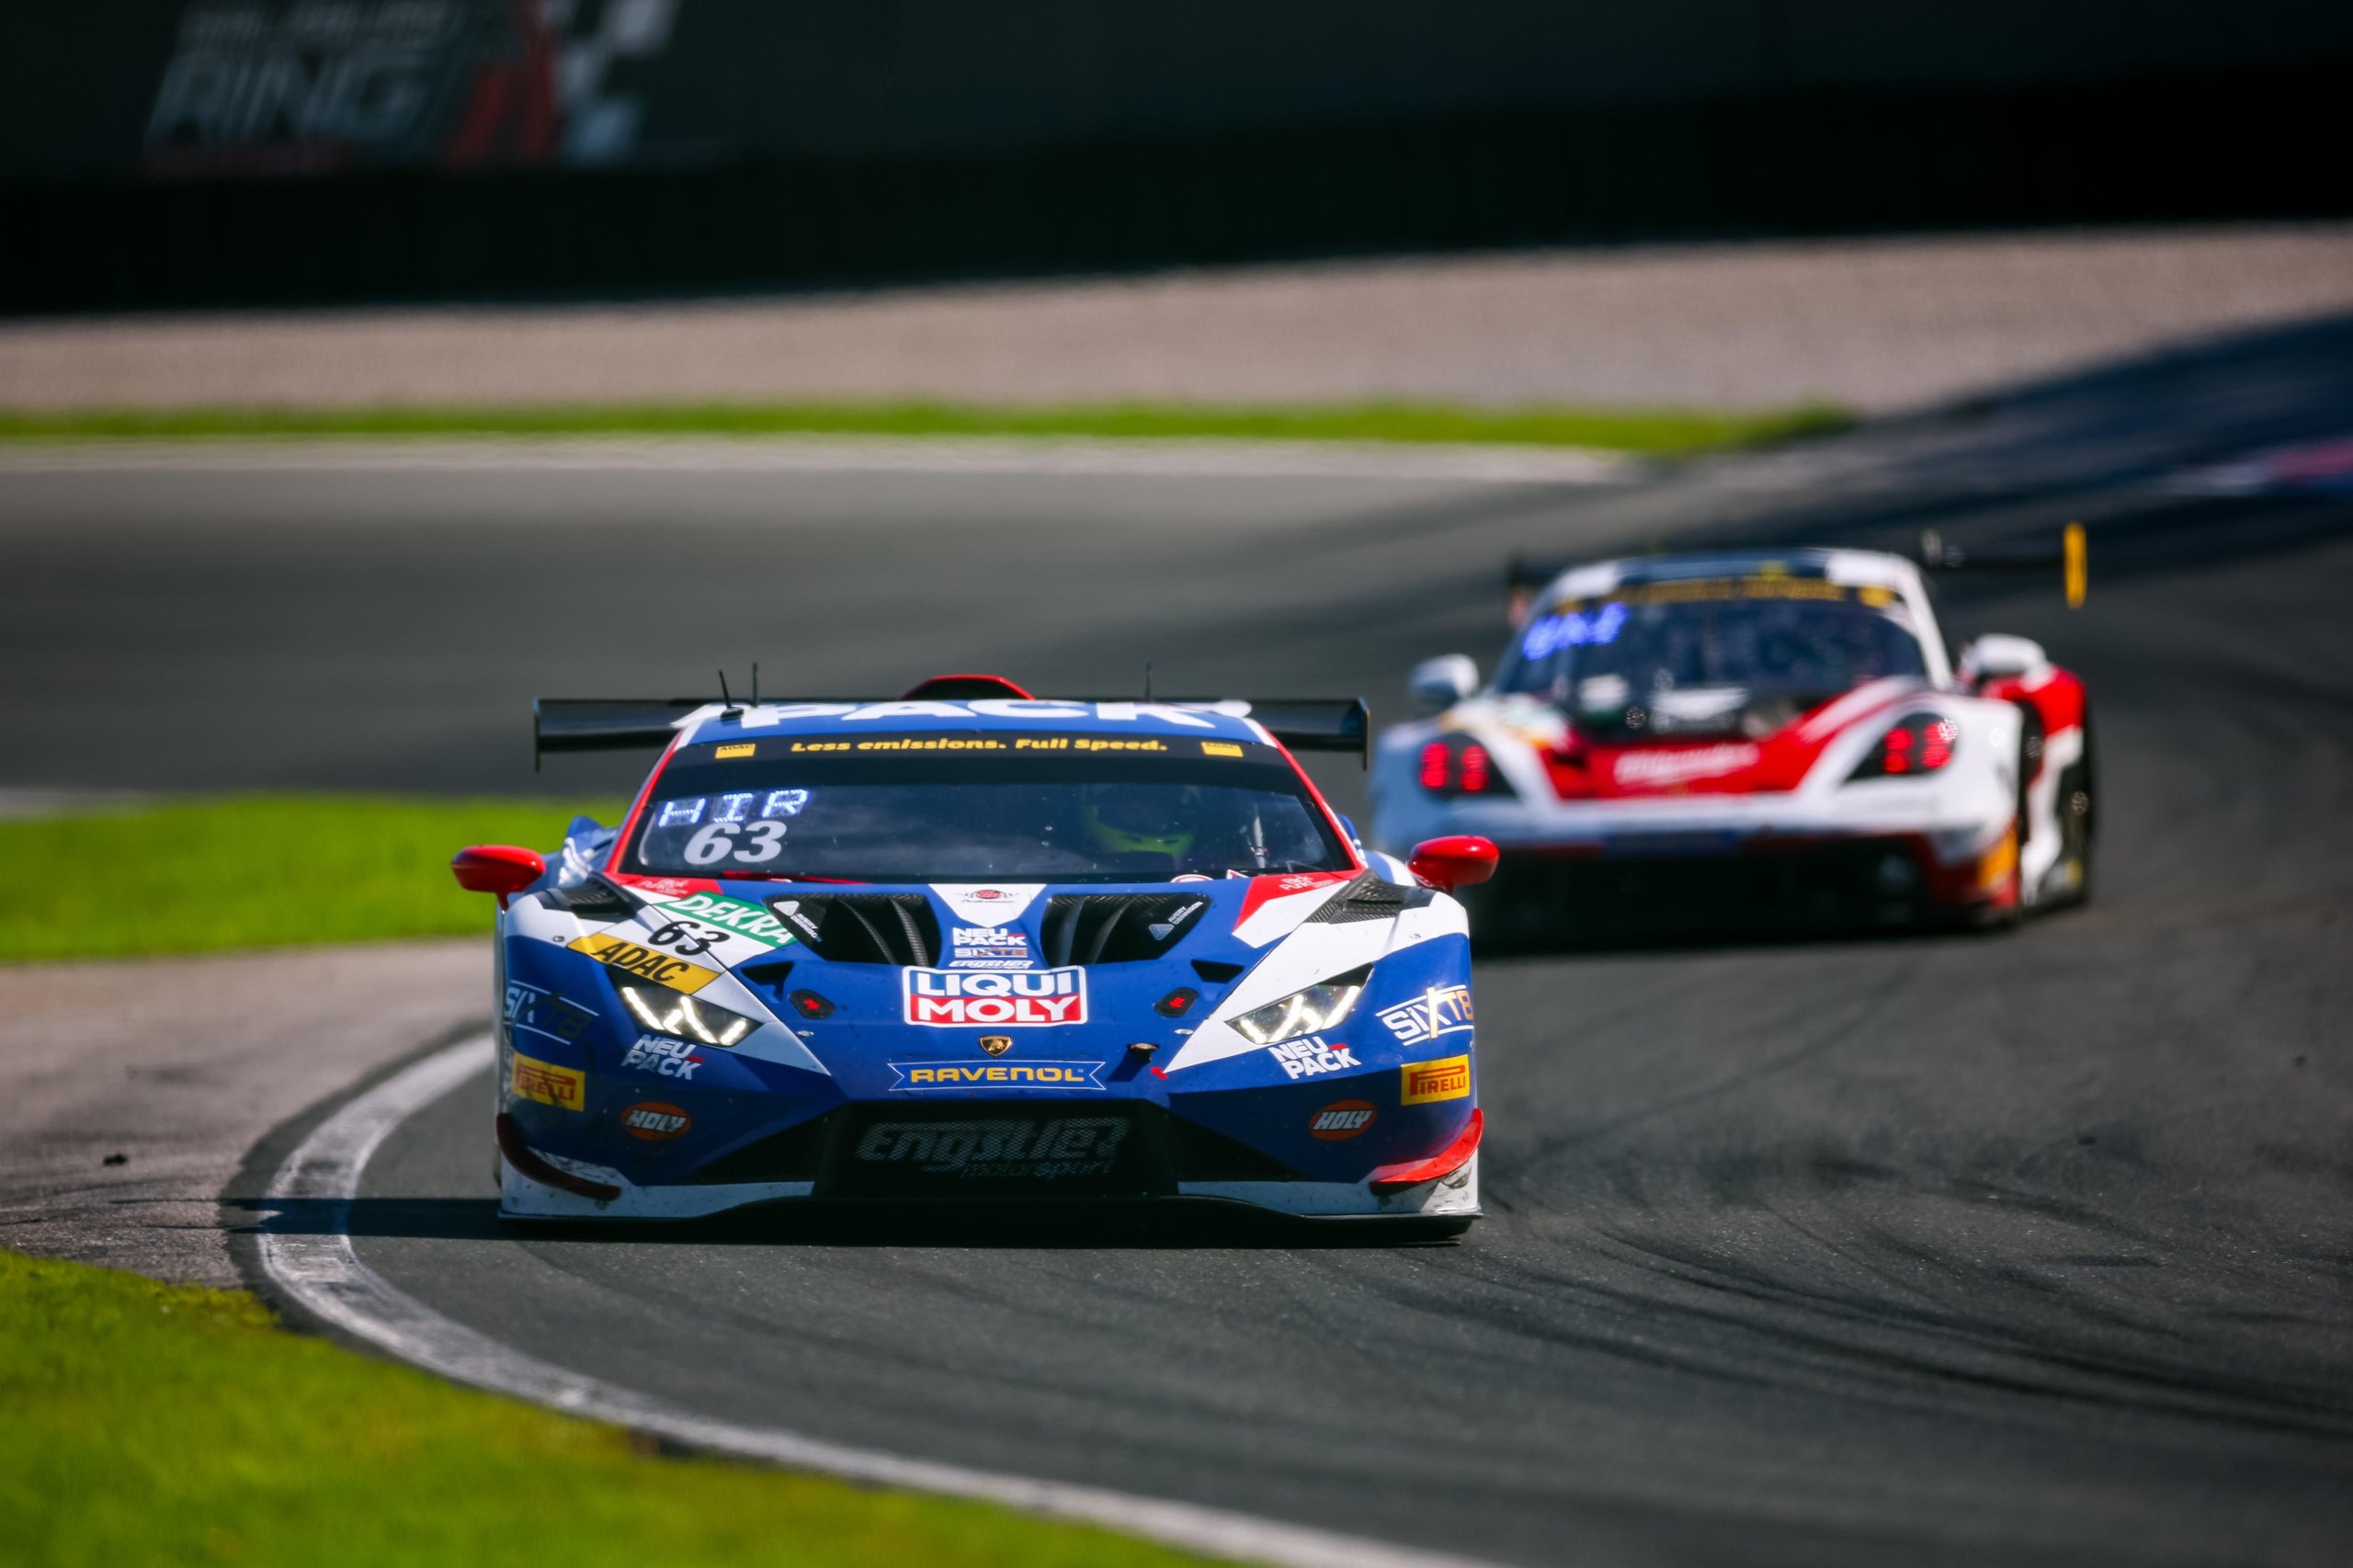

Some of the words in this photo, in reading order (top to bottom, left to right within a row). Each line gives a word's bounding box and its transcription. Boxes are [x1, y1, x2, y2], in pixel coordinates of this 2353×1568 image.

[790, 741, 851, 753] Less
[857, 738, 1007, 751] emissions.
[1015, 738, 1068, 749] Full
[1074, 738, 1168, 752] Speed.
[658, 789, 809, 827] HIR
[684, 820, 788, 865] 63
[665, 894, 794, 944] DEKRA
[953, 927, 1007, 938] NEU
[648, 921, 731, 956] 63
[953, 936, 1027, 946] PACK
[591, 941, 689, 983] ADAC
[916, 971, 1072, 997] LIQUI
[917, 995, 1079, 1023] MOLY
[632, 1033, 697, 1059] NEU
[1267, 1035, 1330, 1062] NEU
[620, 1049, 702, 1080] PACK
[910, 1067, 1085, 1083] RAVENOL
[1280, 1048, 1362, 1079] PACK
[513, 1062, 578, 1102] PIRELLI
[1409, 1064, 1467, 1096] PIRELLI
[625, 1108, 688, 1132] HOLY
[1313, 1110, 1373, 1131] HOLY
